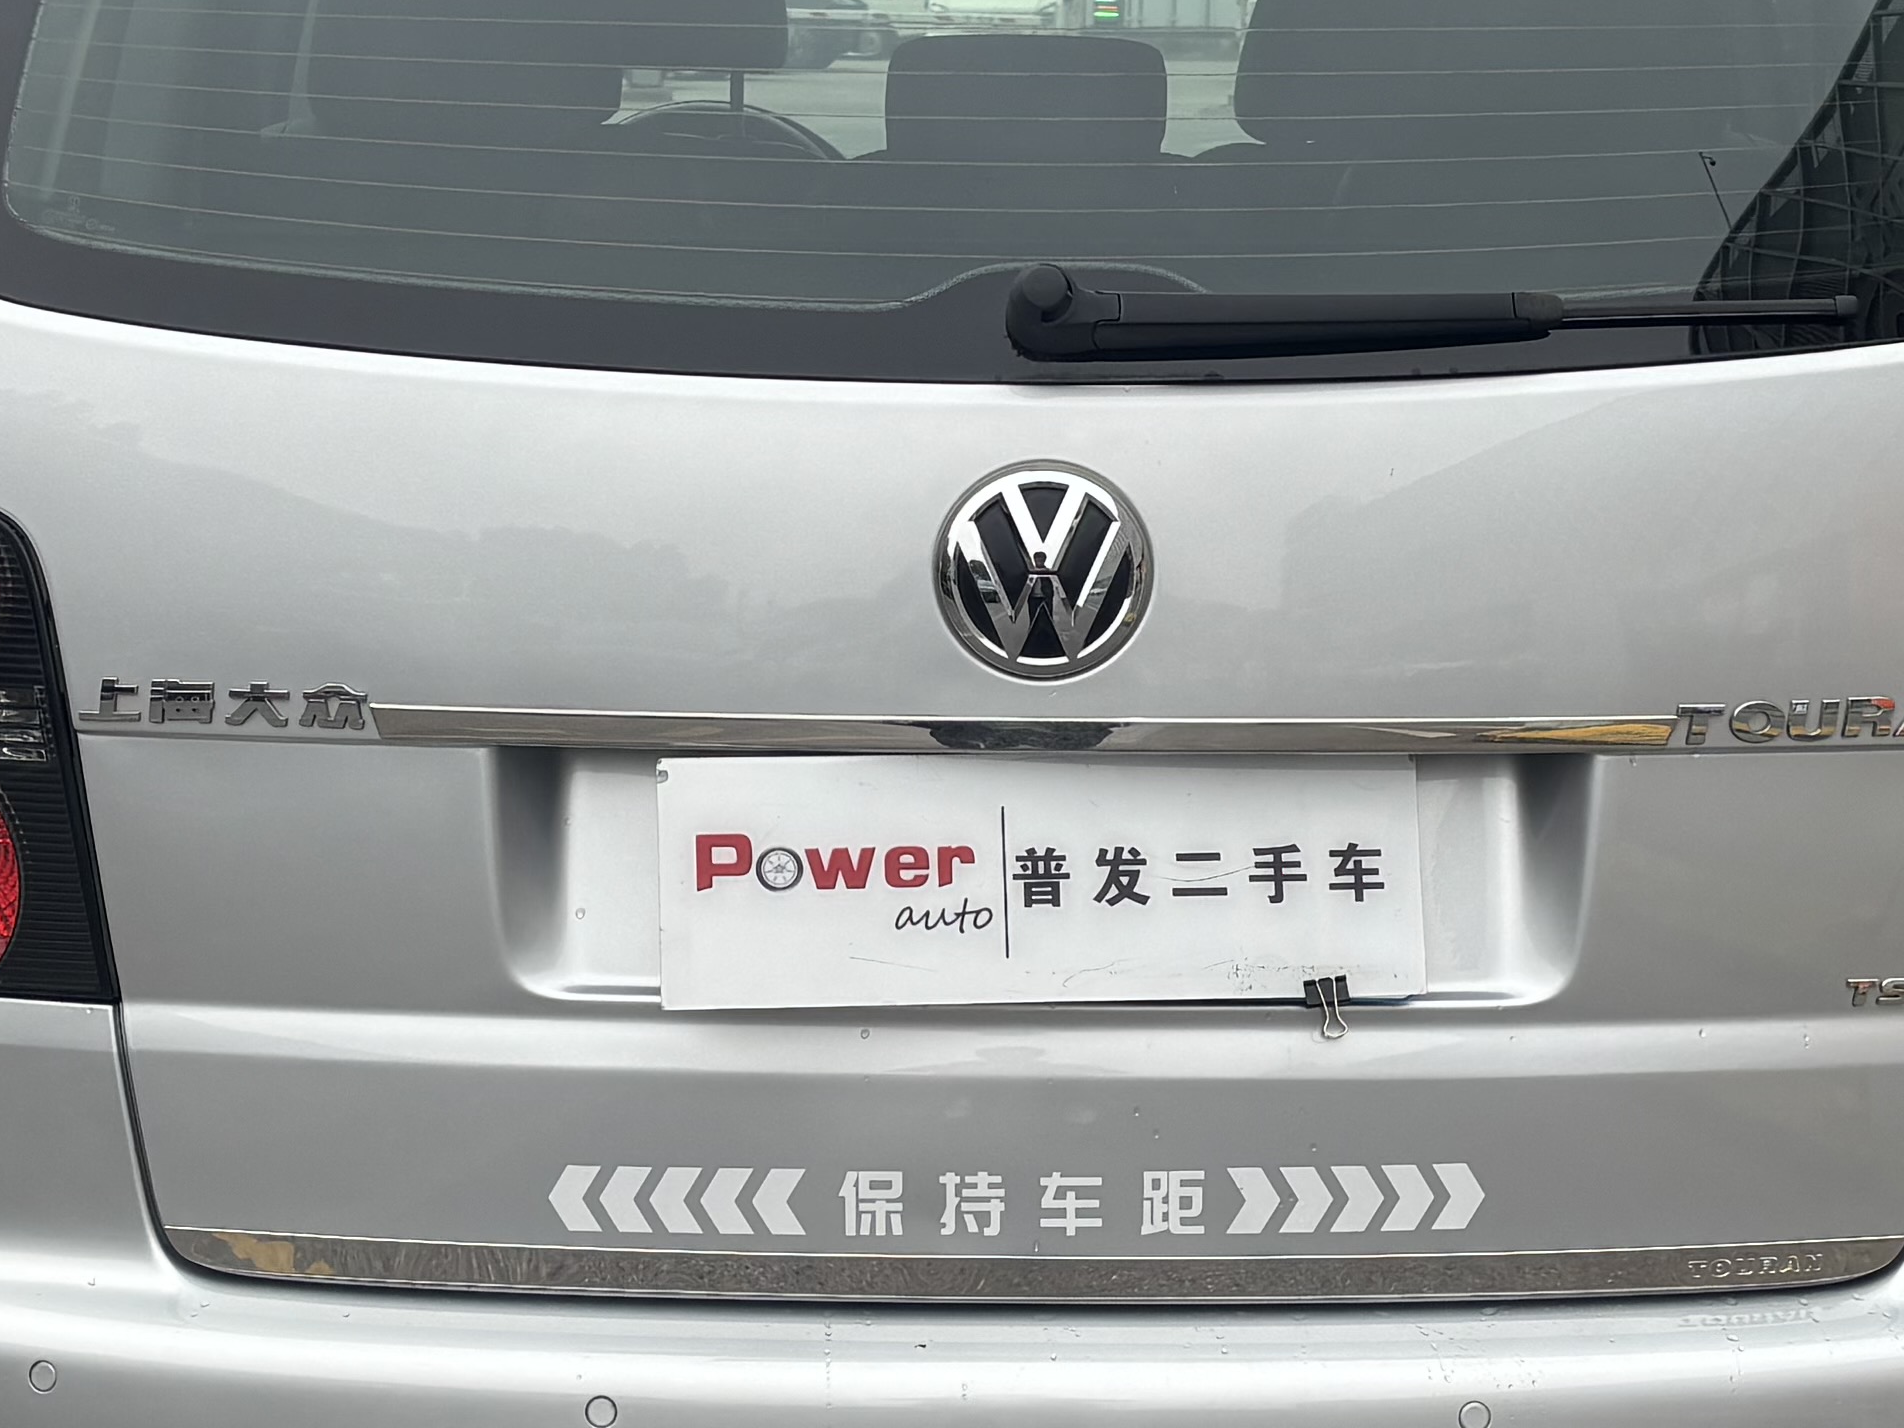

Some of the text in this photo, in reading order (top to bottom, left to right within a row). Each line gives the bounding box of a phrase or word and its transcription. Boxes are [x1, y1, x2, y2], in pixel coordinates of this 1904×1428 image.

[79, 676, 368, 730] 上海大众
[695, 833, 976, 893] Power
[1011, 843, 1386, 908] 普发二手车
[894, 897, 994, 933] auto
[838, 1170, 1206, 1236] 保持车距
